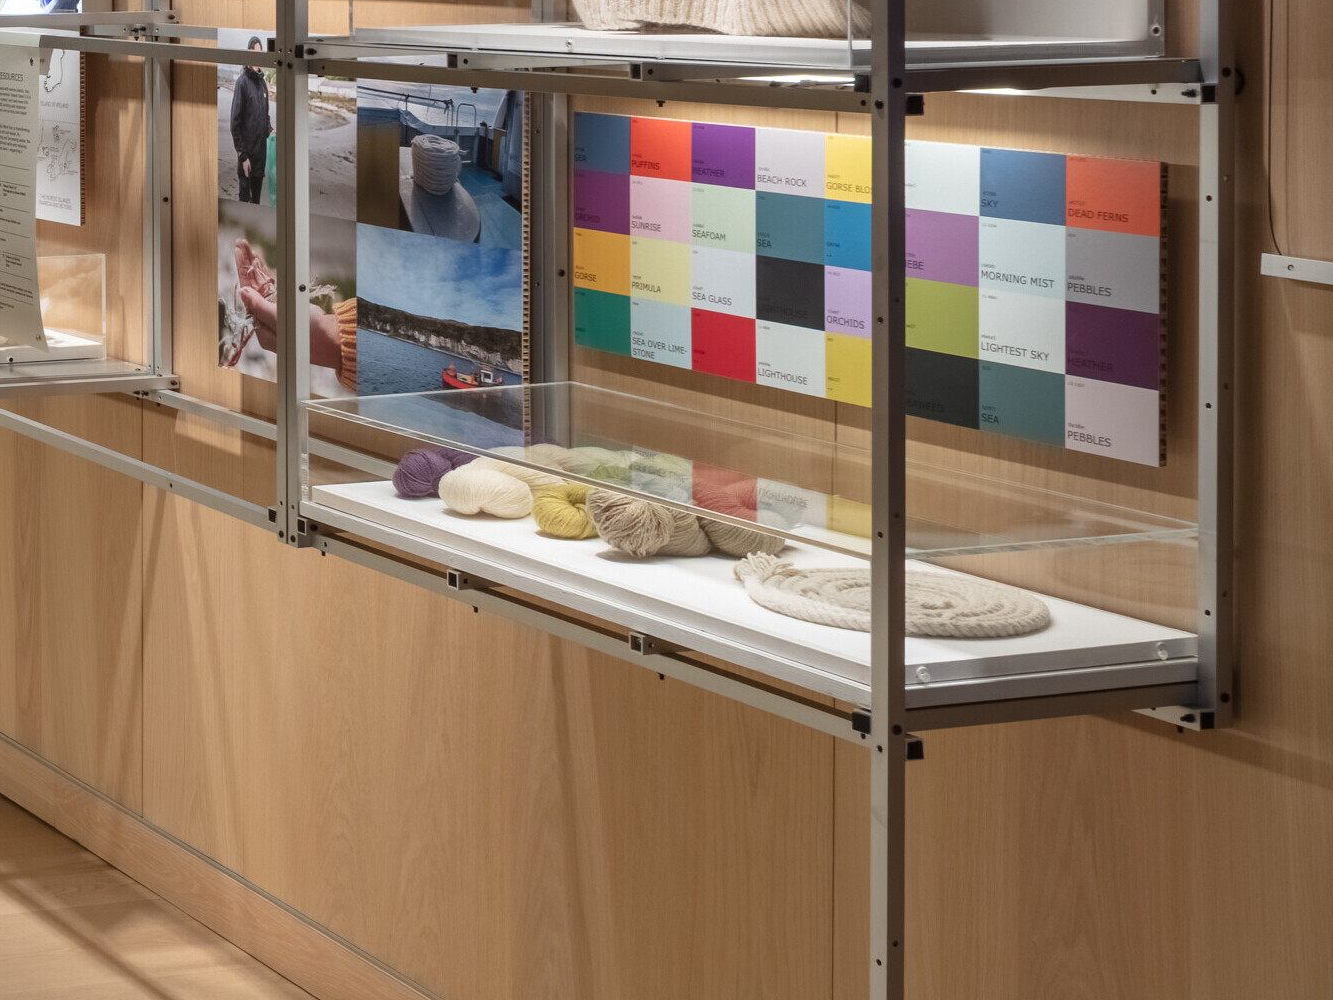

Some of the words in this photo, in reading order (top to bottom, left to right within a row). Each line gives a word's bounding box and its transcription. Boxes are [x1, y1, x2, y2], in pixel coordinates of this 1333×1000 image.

[574, 153, 587, 162] SEA
[631, 160, 660, 171] PUFFINS
[692, 167, 725, 178] HEATHER
[757, 174, 782, 185] BEACH
[785, 177, 807, 188] ROCK
[826, 181, 852, 193] GORSE
[981, 199, 998, 209] SKY
[1068, 208, 1094, 219] DEAD
[1097, 211, 1129, 223] FERNS
[631, 220, 661, 232] SUNRISE
[692, 229, 726, 241] SEAFOAM
[757, 239, 772, 248] SEA
[574, 271, 597, 283] GORSE
[981, 270, 1027, 285] MORNING
[1030, 277, 1055, 289] MIST
[631, 281, 661, 293] PRIMULA
[1067, 282, 1112, 297] PEBBLES
[692, 292, 706, 301] SEA
[708, 294, 732, 306] GLASS
[827, 315, 866, 330] ORCHIDS
[632, 337, 645, 346] SEA
[647, 339, 666, 350] OVER
[667, 342, 687, 354] LIME-
[981, 342, 1027, 357] LIGHTEST
[1030, 350, 1050, 361] SKY
[632, 347, 655, 359] STONE
[1068, 357, 1113, 373] HEATHER
[757, 367, 808, 386] LIGHTHOUSE
[905, 397, 945, 414] EAWEED
[981, 413, 999, 425] SEA
[1067, 430, 1112, 448] PEBBLES
